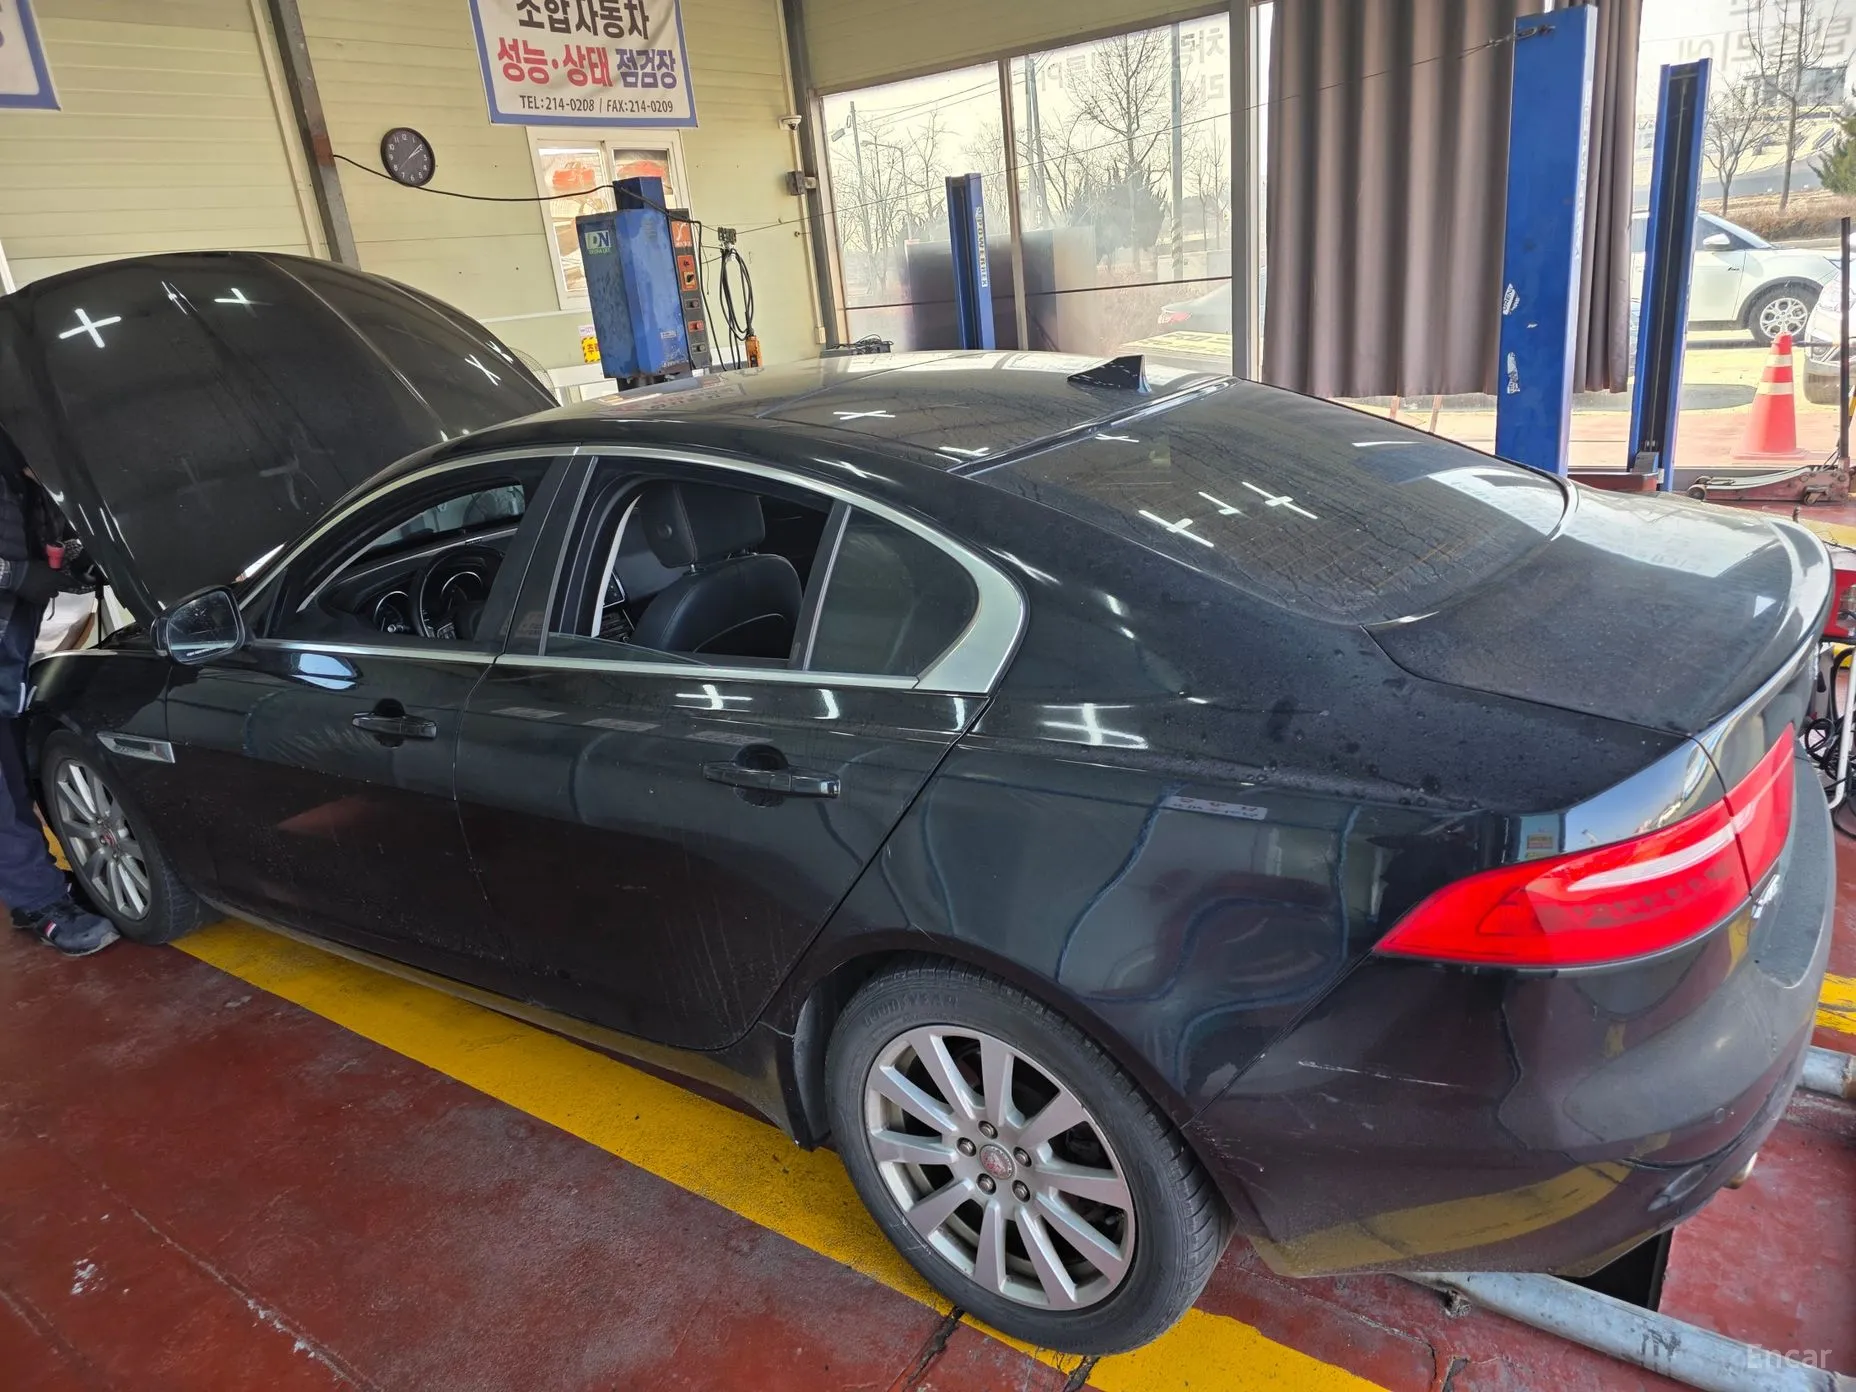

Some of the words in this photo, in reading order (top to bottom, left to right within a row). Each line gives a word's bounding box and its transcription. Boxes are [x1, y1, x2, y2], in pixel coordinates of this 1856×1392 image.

[497, 37, 613, 87] 성능·상태
[615, 48, 677, 89] 점검장
[519, 95, 595, 112] TEL:214-0208
[606, 99, 674, 113] FAX:214-0209
